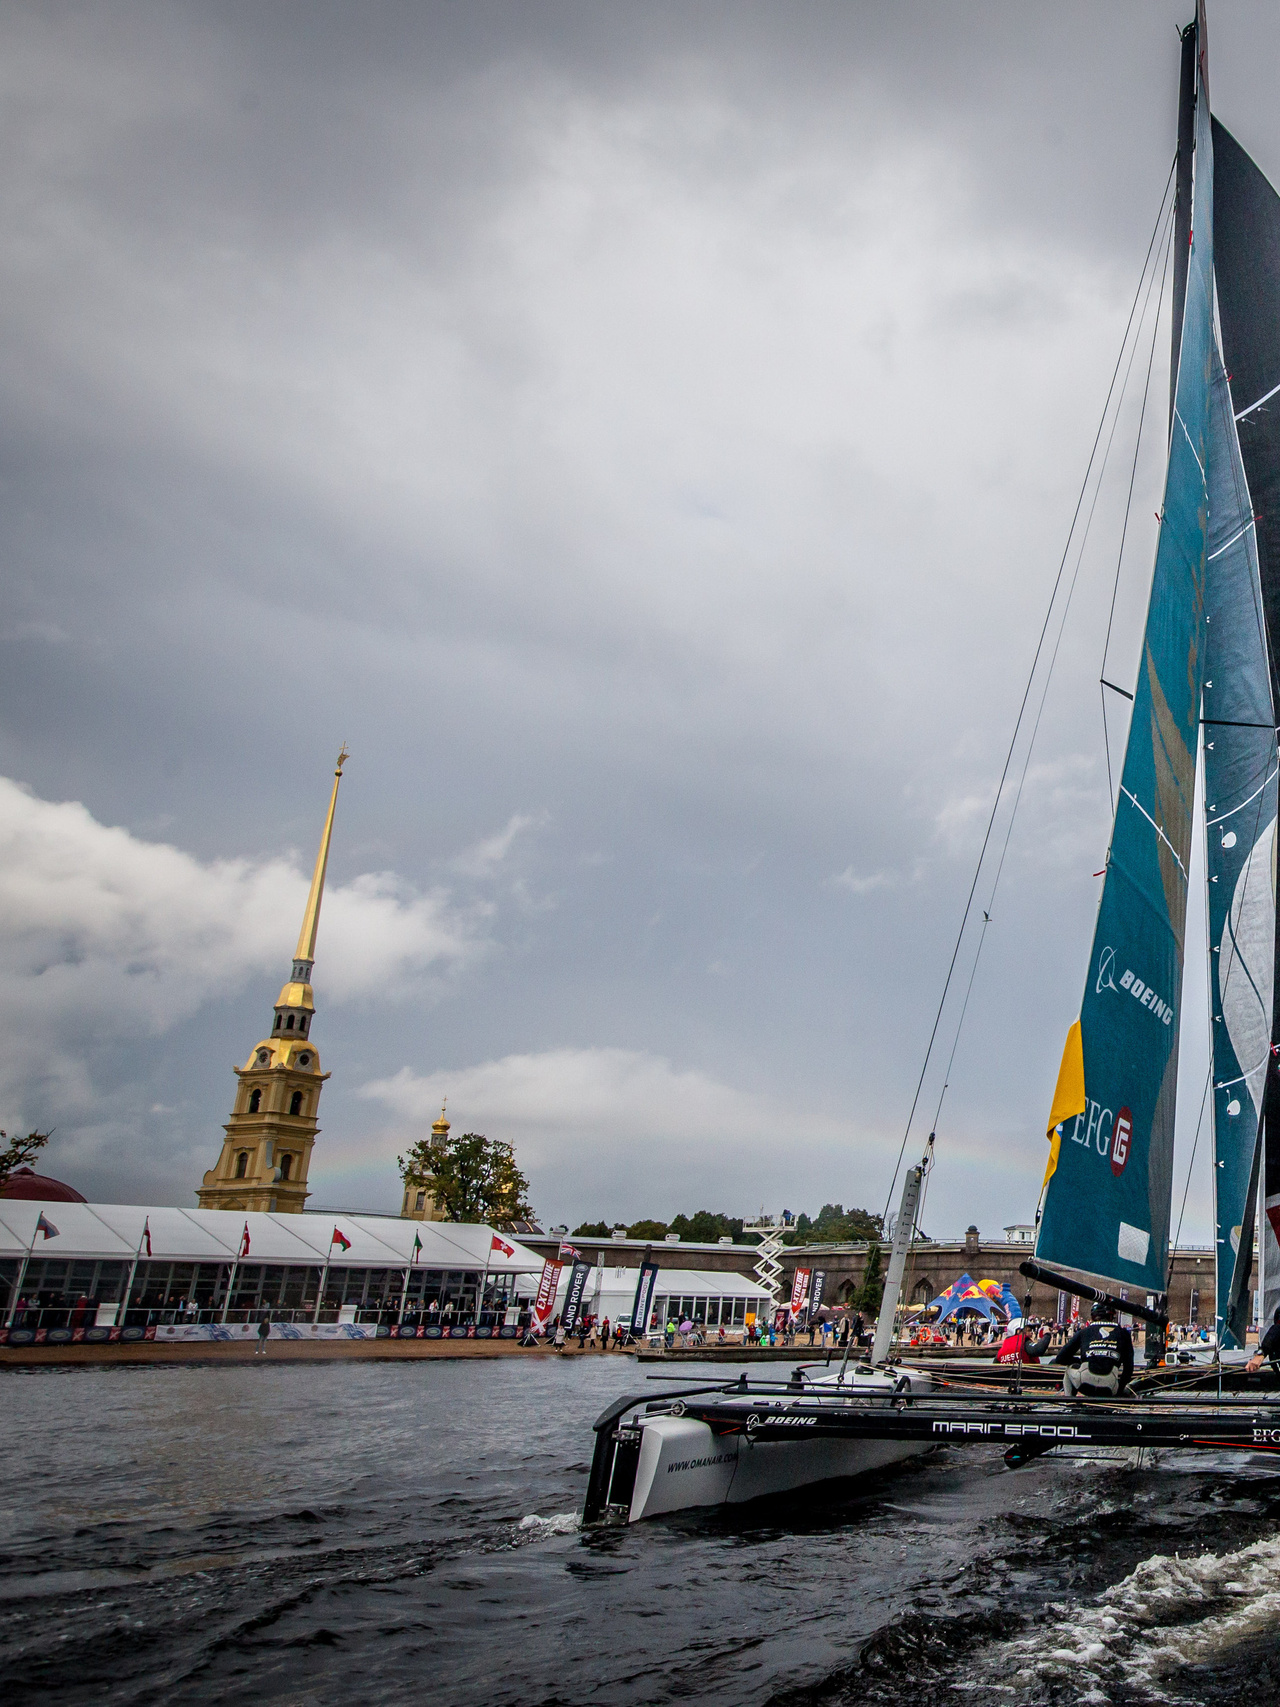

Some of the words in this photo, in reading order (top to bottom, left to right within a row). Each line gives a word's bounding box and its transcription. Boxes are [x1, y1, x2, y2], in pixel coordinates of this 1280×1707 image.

[1119, 969, 1174, 1026] BOEING
[1071, 1097, 1113, 1156] EFG
[537, 1261, 554, 1310] EXTREME
[570, 1272, 584, 1304] ROVER
[792, 1269, 804, 1307] EXTREME
[814, 1278, 823, 1302] ROVER
[564, 1305, 577, 1329] LAND
[764, 1415, 818, 1425] BOEING
[667, 1452, 739, 1473] WWW.OMANAIR.COM
